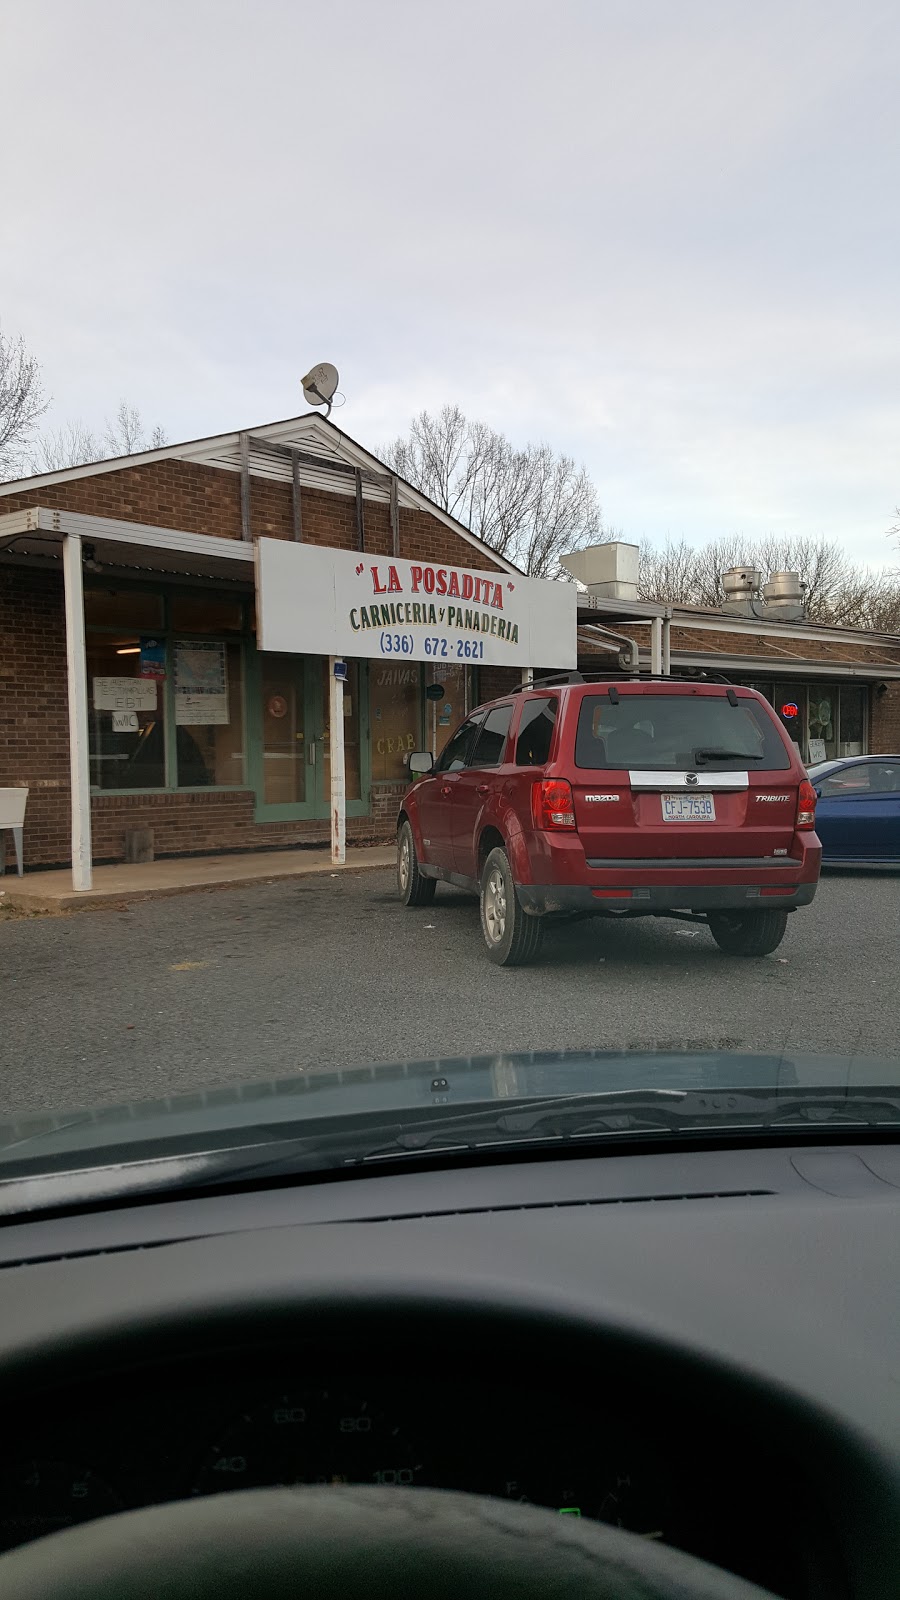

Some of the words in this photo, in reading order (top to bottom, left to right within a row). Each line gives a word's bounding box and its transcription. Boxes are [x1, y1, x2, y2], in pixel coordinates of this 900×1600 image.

[349, 602, 437, 632] CARNICERIA
[447, 605, 519, 645] PANADERIA
[380, 631, 414, 655] (336)
[377, 669, 418, 686] JAIVAS
[115, 697, 144, 709] EBT
[782, 705, 798, 716] OPEN
[113, 714, 137, 727] WIC
[376, 733, 416, 754] CRAB
[755, 795, 791, 803] TRIBUTE
[213, 1456, 246, 1471] 40
[374, 1469, 413, 1483] 100
